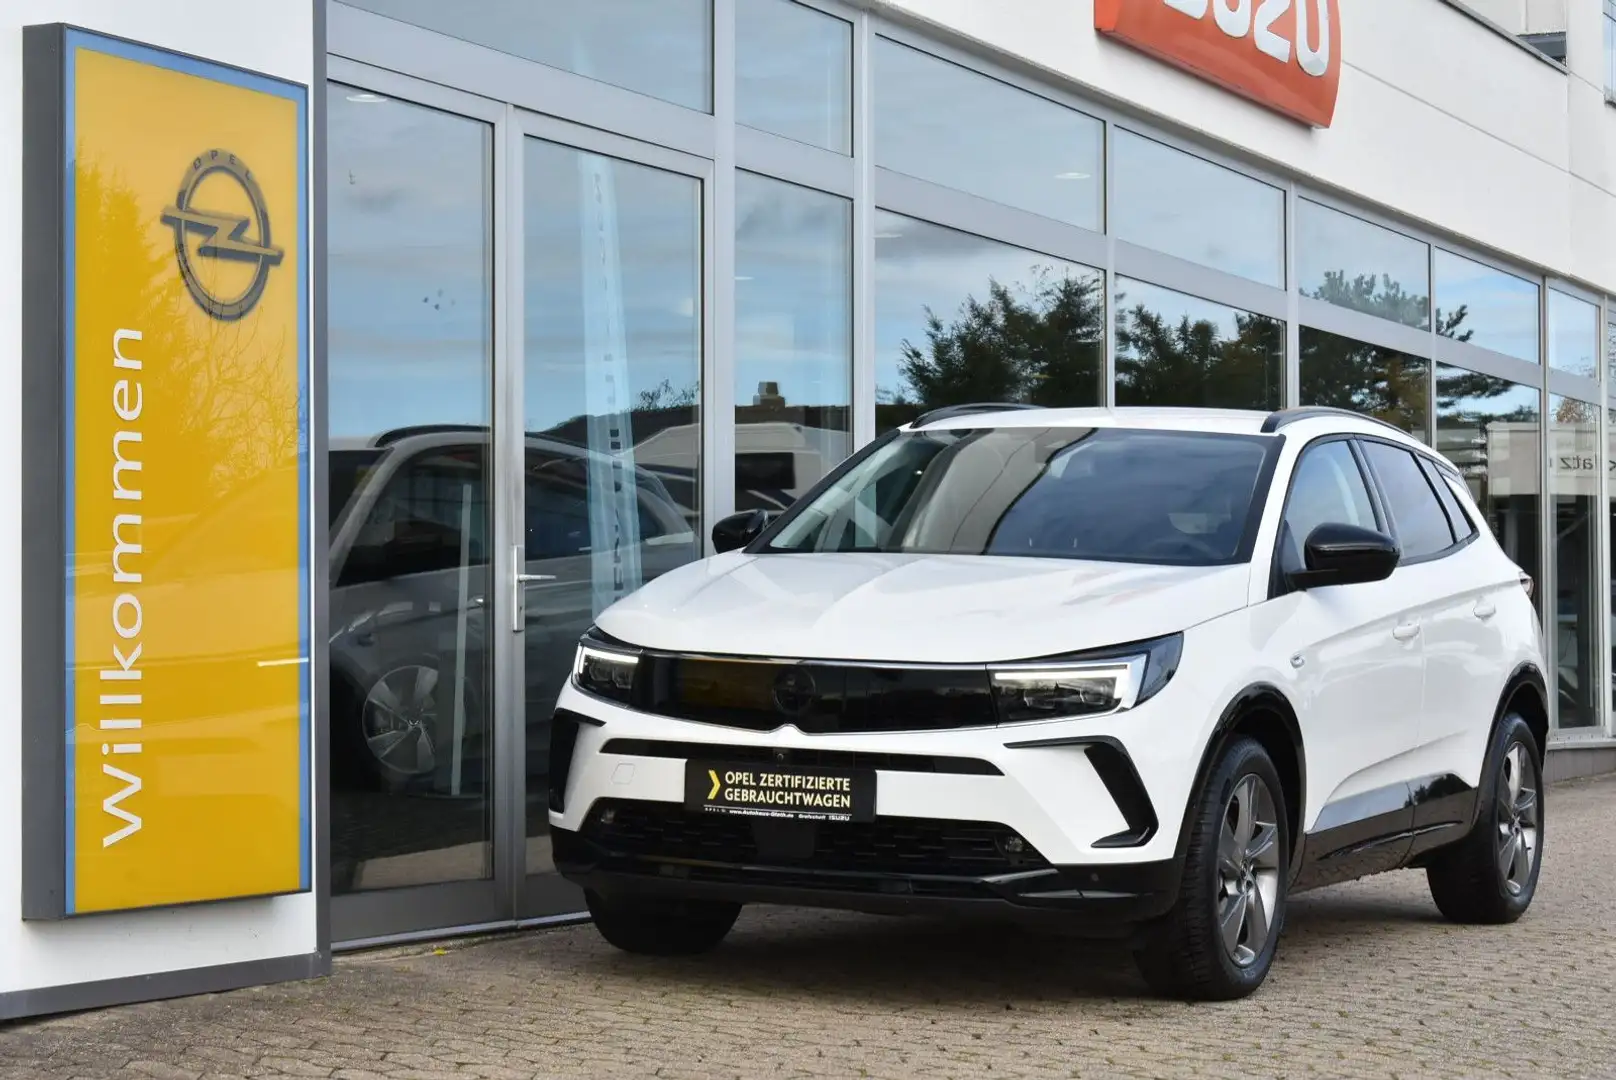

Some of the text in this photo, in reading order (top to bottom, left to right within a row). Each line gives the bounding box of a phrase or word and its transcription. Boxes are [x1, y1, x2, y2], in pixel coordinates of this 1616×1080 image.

[193, 149, 253, 181] OPEL
[100, 328, 144, 848] Willkommen
[725, 771, 851, 791] OPEL ZERTIFIZIERTE
[725, 788, 851, 808] GEBRAUCHTWAGEN
